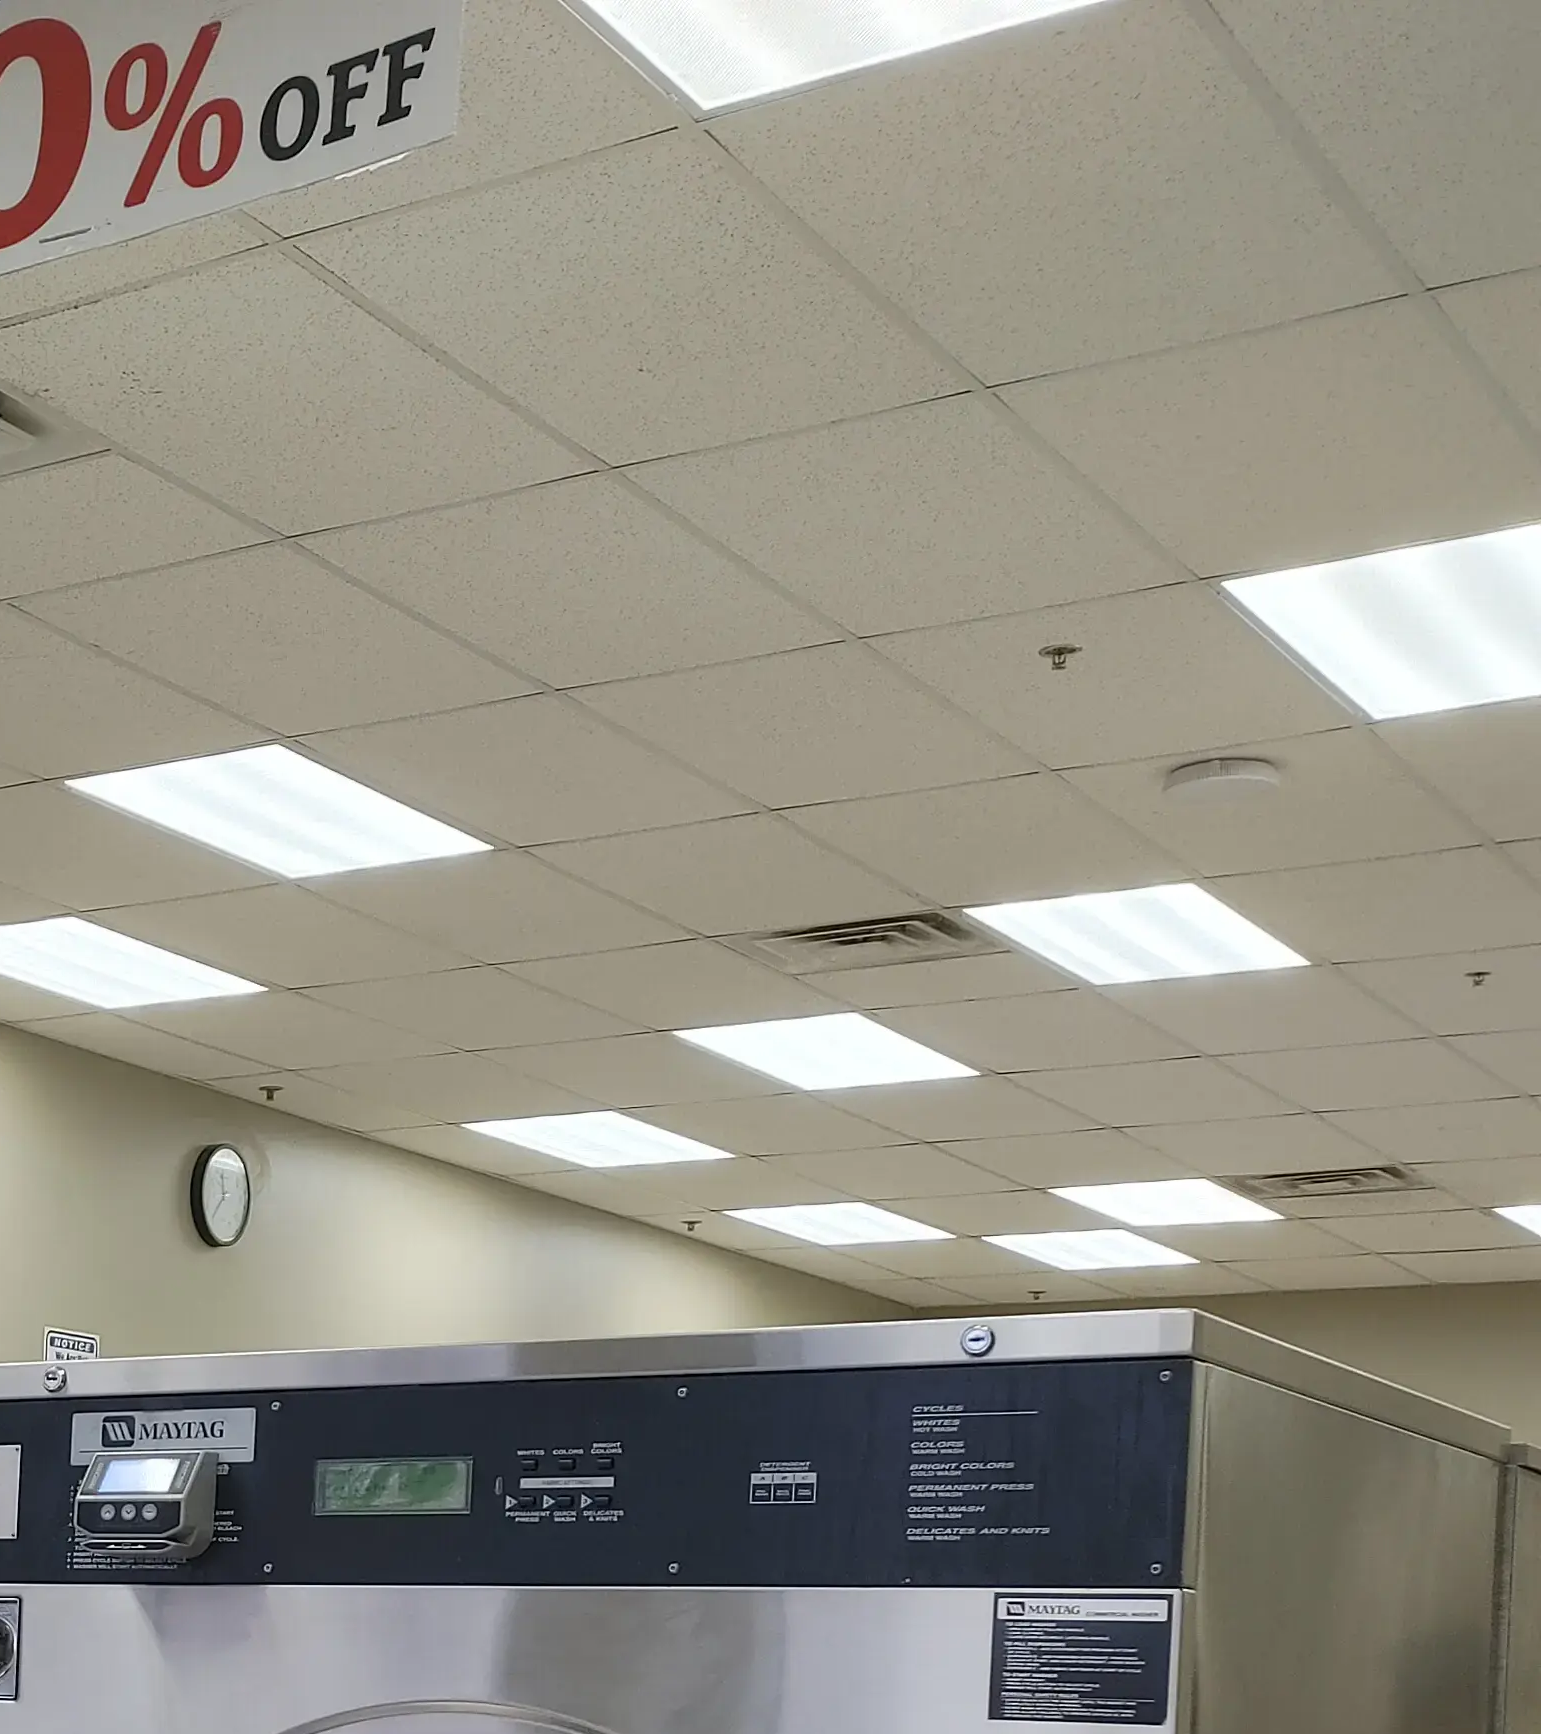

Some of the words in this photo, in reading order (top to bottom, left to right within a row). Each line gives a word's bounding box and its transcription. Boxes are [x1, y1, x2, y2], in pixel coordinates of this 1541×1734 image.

[259, 28, 435, 161] OFF
[54, 1338, 91, 1351] NOTICE
[139, 1420, 225, 1441] MAYTAG
[959, 1462, 1015, 1470] COLORS
[908, 1484, 989, 1492] PERMANENT
[1028, 1605, 1081, 1615] MAYTAG
